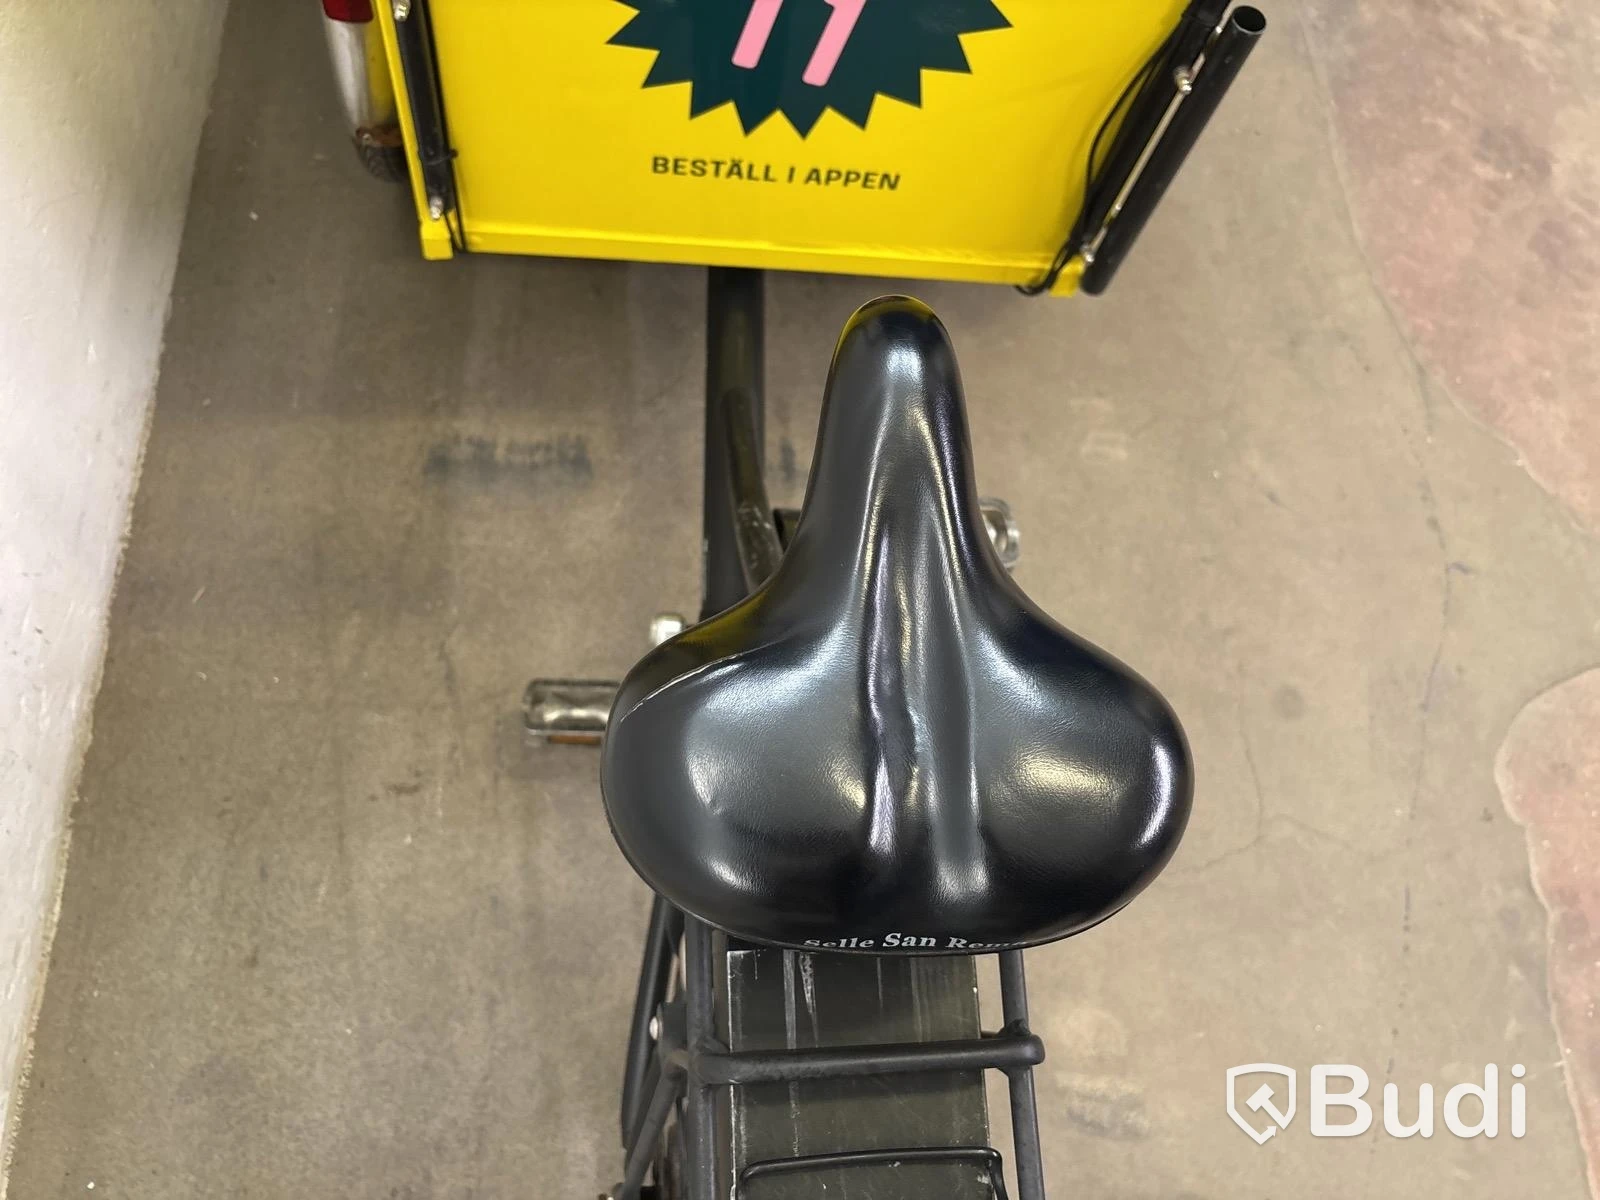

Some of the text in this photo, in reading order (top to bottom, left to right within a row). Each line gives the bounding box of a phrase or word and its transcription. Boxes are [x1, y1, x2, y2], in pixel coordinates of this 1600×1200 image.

[652, 155, 900, 191] BESTÄLL I APPEN
[882, 932, 937, 948] San
